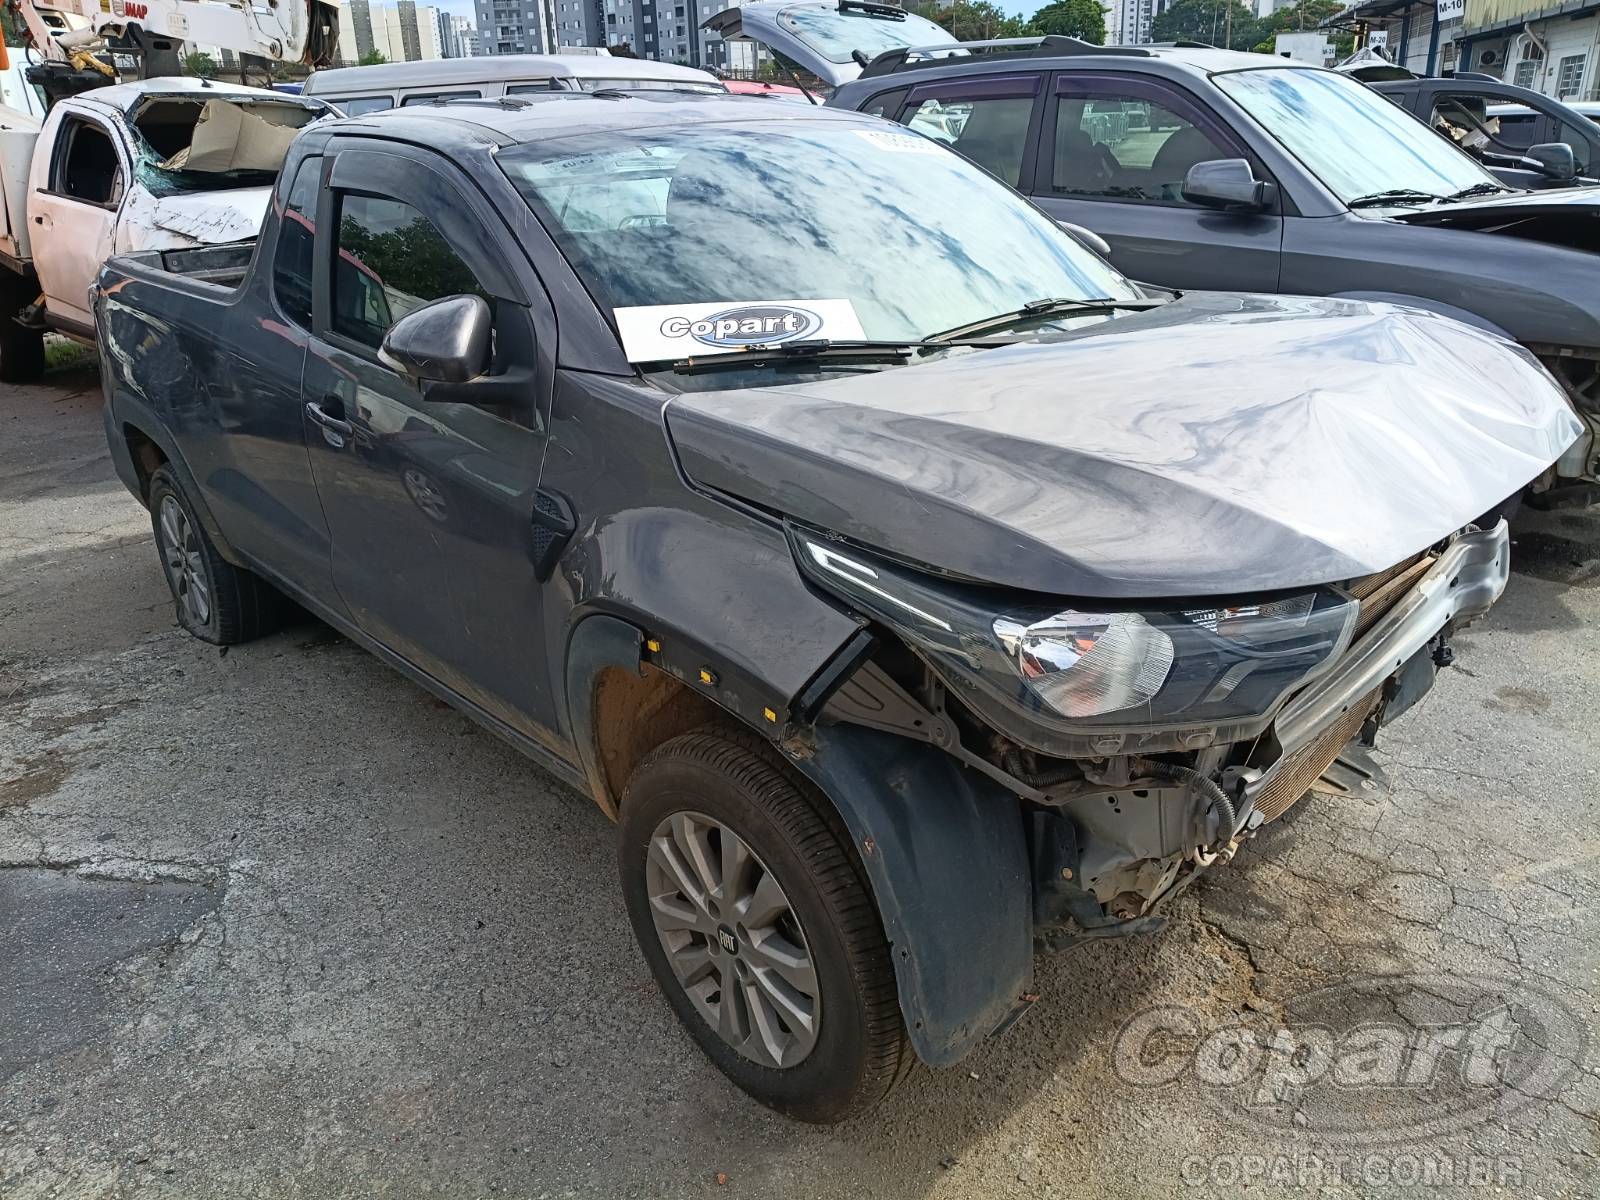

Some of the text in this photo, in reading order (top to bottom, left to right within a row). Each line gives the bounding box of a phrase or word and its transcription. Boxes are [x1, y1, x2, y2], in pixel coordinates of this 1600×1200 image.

[1439, 0, 1462, 13] M-10
[1370, 36, 1386, 44] M-20
[660, 311, 799, 341] Copart
[719, 929, 735, 952] FIAT
